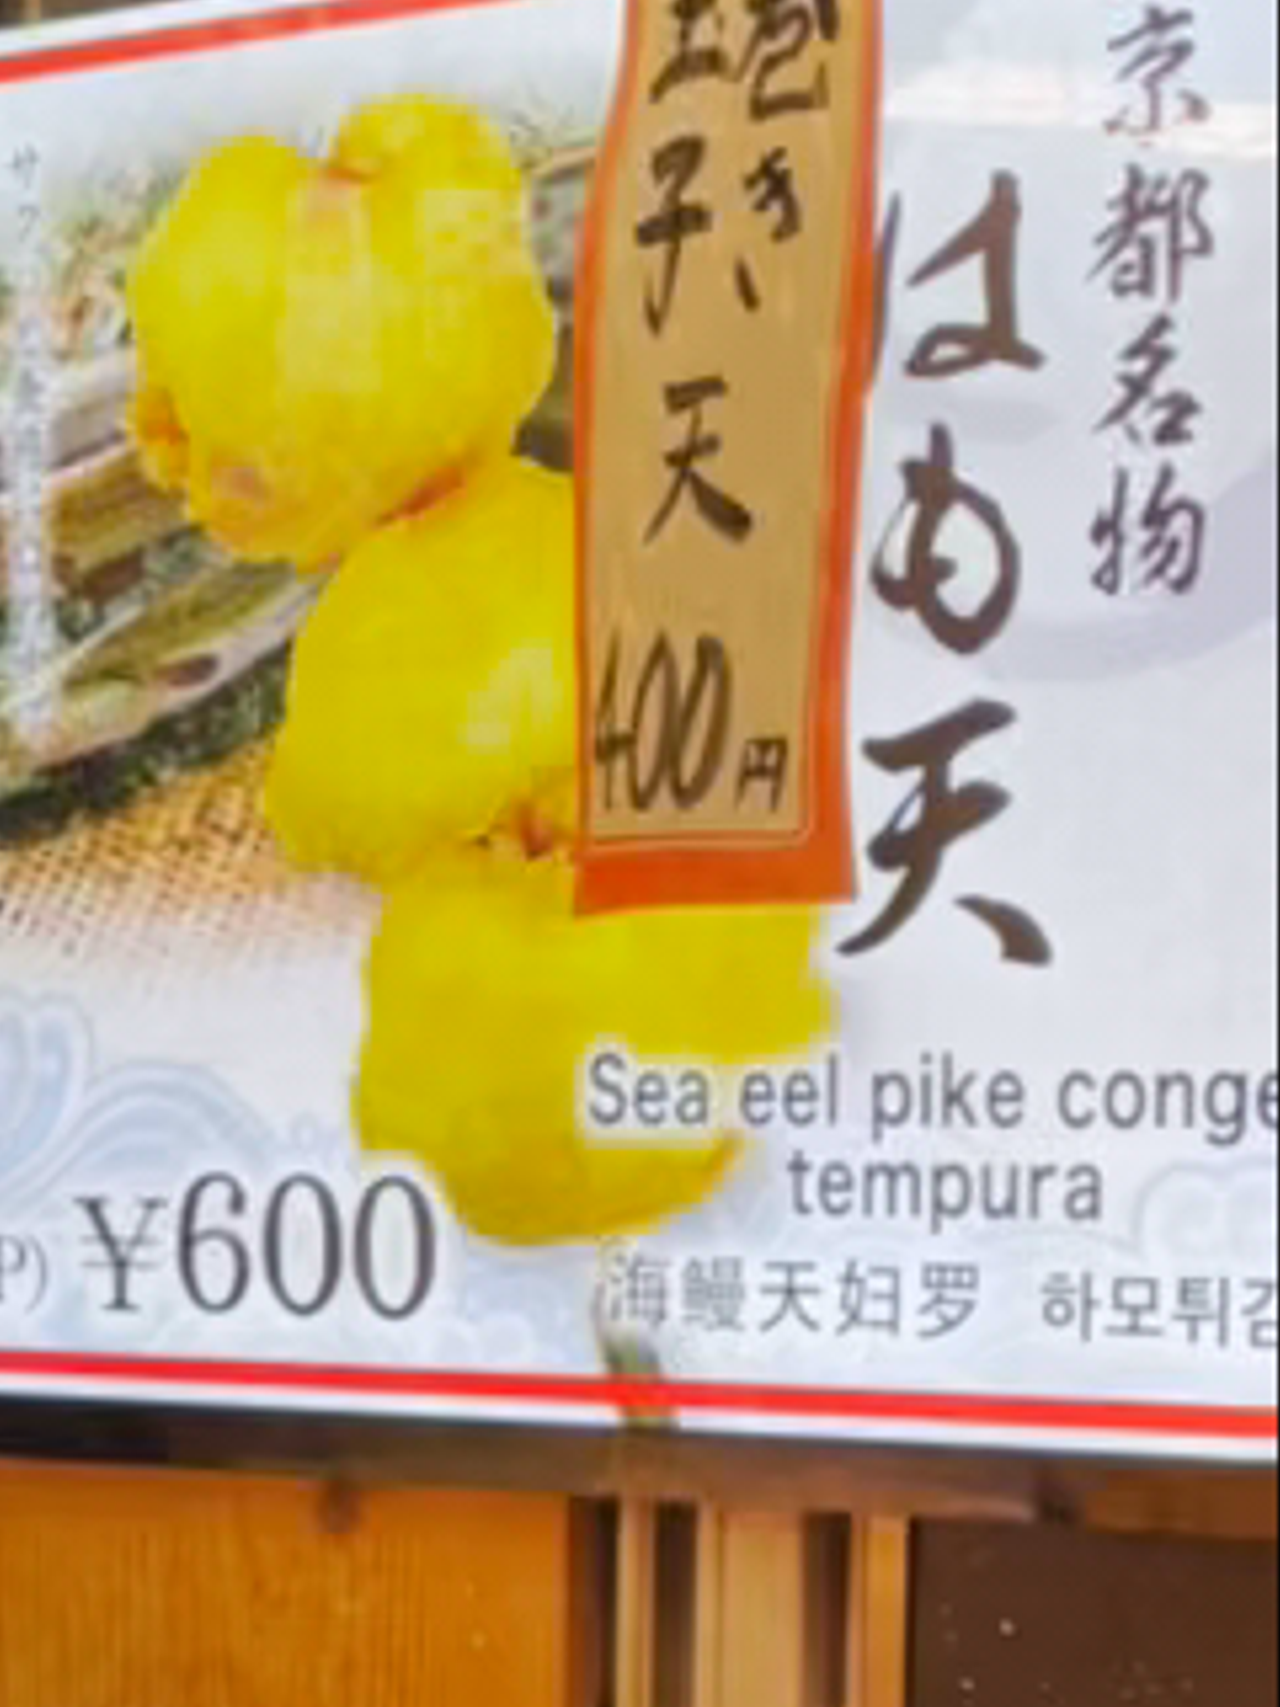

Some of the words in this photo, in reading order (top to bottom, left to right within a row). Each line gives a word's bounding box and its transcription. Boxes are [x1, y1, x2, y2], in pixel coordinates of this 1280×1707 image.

[1085, 4, 1214, 597] 京都名物
[833, 169, 1054, 968] はも天
[592, 623, 787, 815] 400円
[588, 1052, 710, 1128] Sea
[740, 1052, 839, 1127] eel
[871, 1053, 1025, 1141] pike
[73, 1171, 438, 1320] ¥600
[787, 1150, 1103, 1232] tempura
[605, 1256, 981, 1338] 海鳗天妇罗
